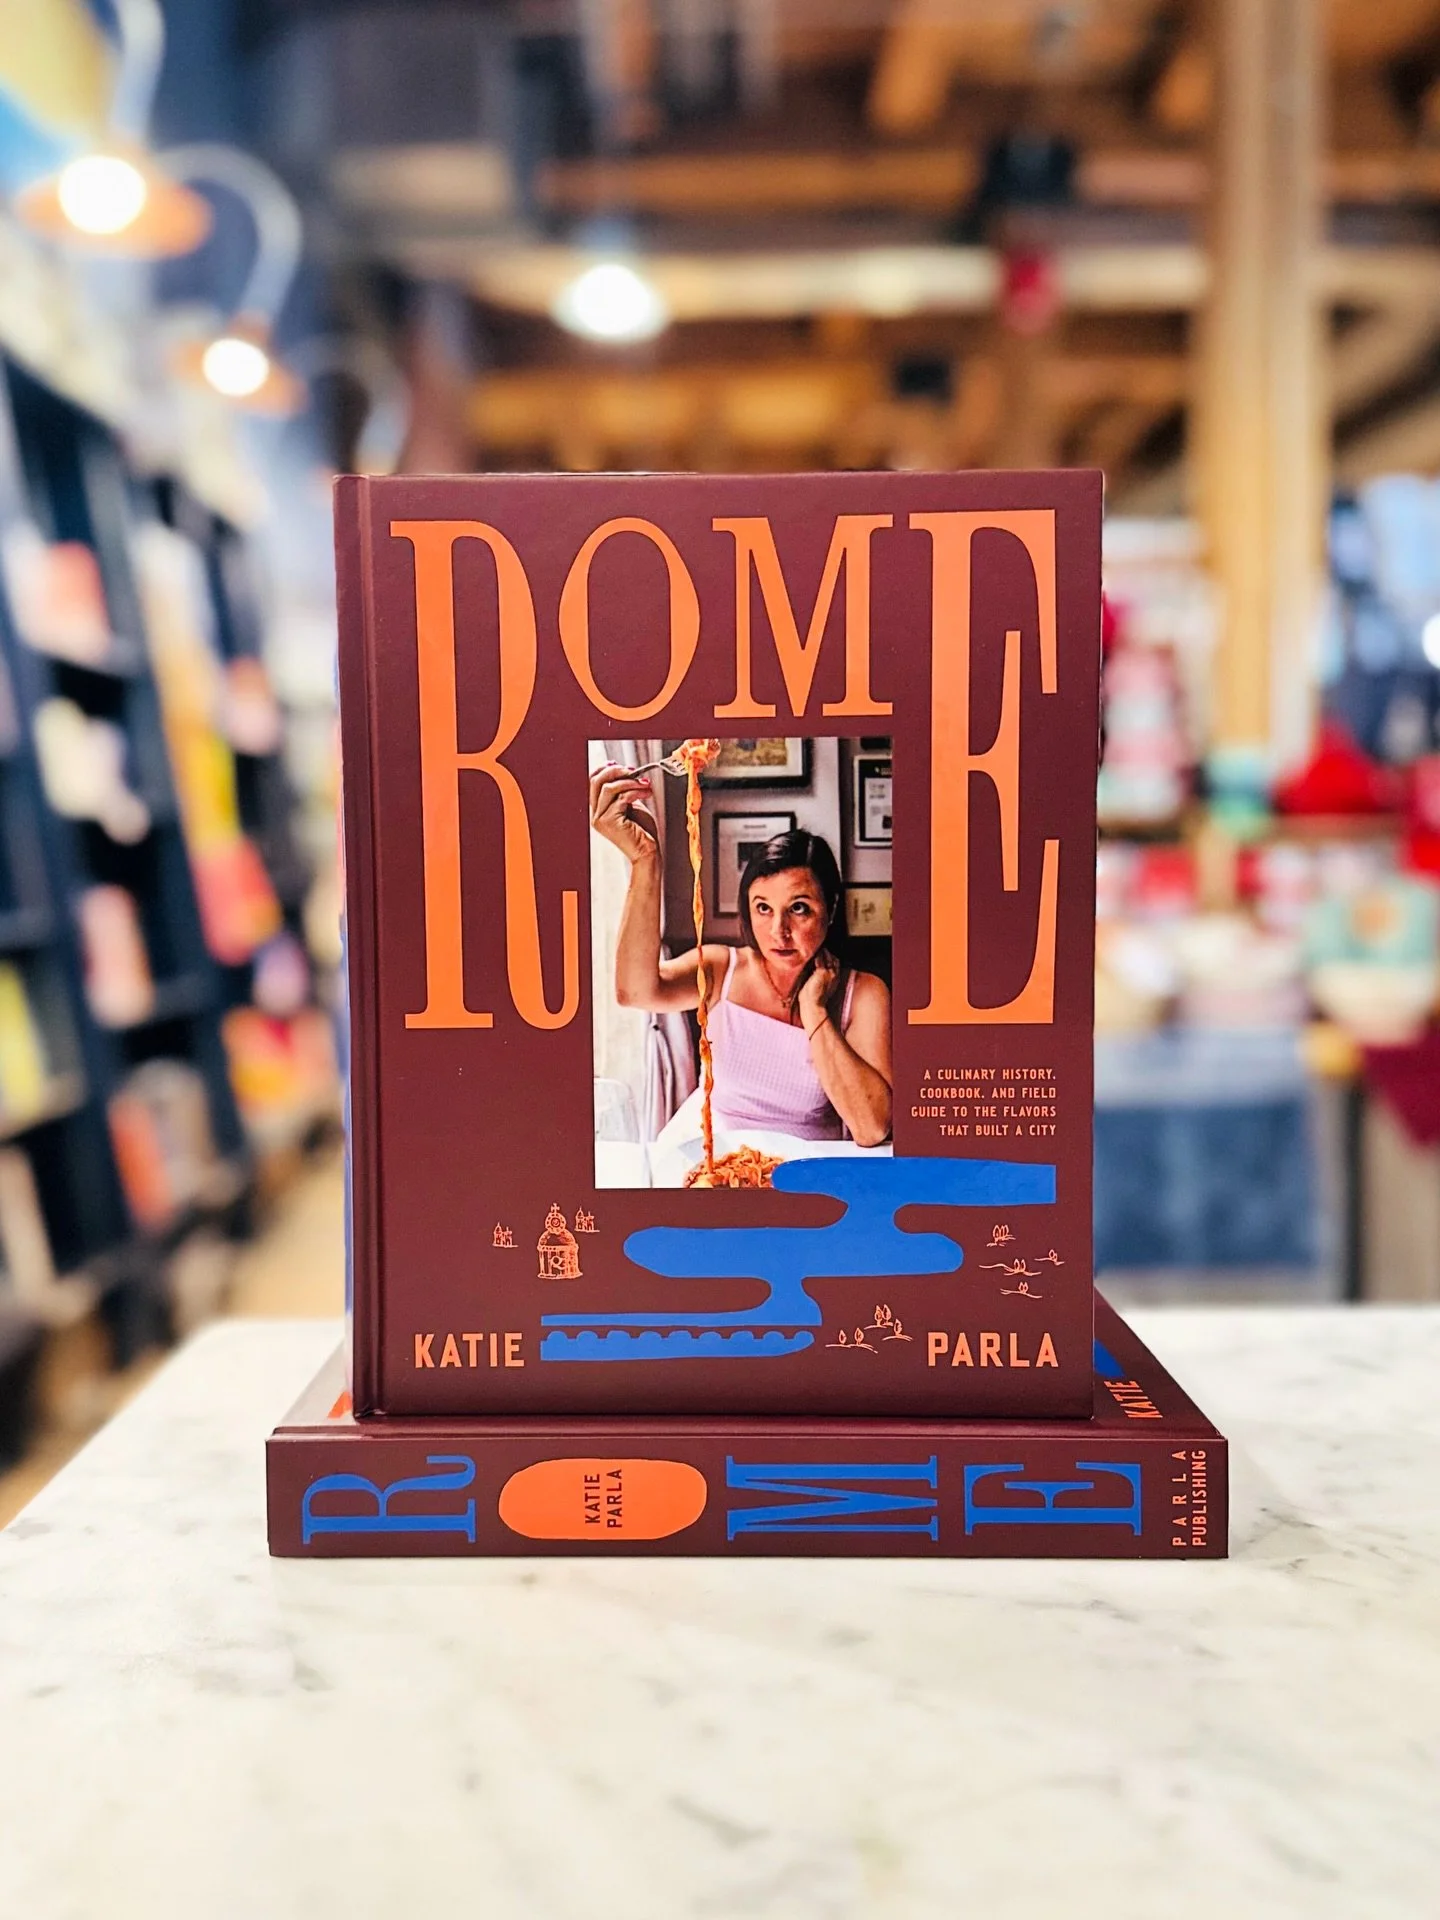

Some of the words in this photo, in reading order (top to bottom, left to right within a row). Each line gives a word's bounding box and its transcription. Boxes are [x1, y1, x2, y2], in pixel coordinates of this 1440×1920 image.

[389, 509, 1060, 1030] ROME
[923, 1069, 931, 1080] A
[937, 1068, 996, 1080] CULINARY
[911, 1106, 947, 1118] GUIDE
[952, 1105, 968, 1118] TO
[973, 1105, 998, 1118] THE
[1003, 1105, 1057, 1117] FLAVORS
[991, 1087, 1015, 1099] AND
[1021, 1087, 1057, 1099] FIELD
[939, 1124, 969, 1136] THAT
[975, 1124, 1009, 1136] BUILT
[1015, 1124, 1023, 1136] A
[1029, 1124, 1057, 1136] CITY
[414, 1332, 525, 1369] KATIE
[927, 1331, 1059, 1368] PARLA
[1103, 1380, 1163, 1418] KATIE
[584, 1473, 601, 1524] KATIE
[606, 1469, 622, 1528] PARLA
[1191, 1450, 1207, 1546] PUBLISHING
